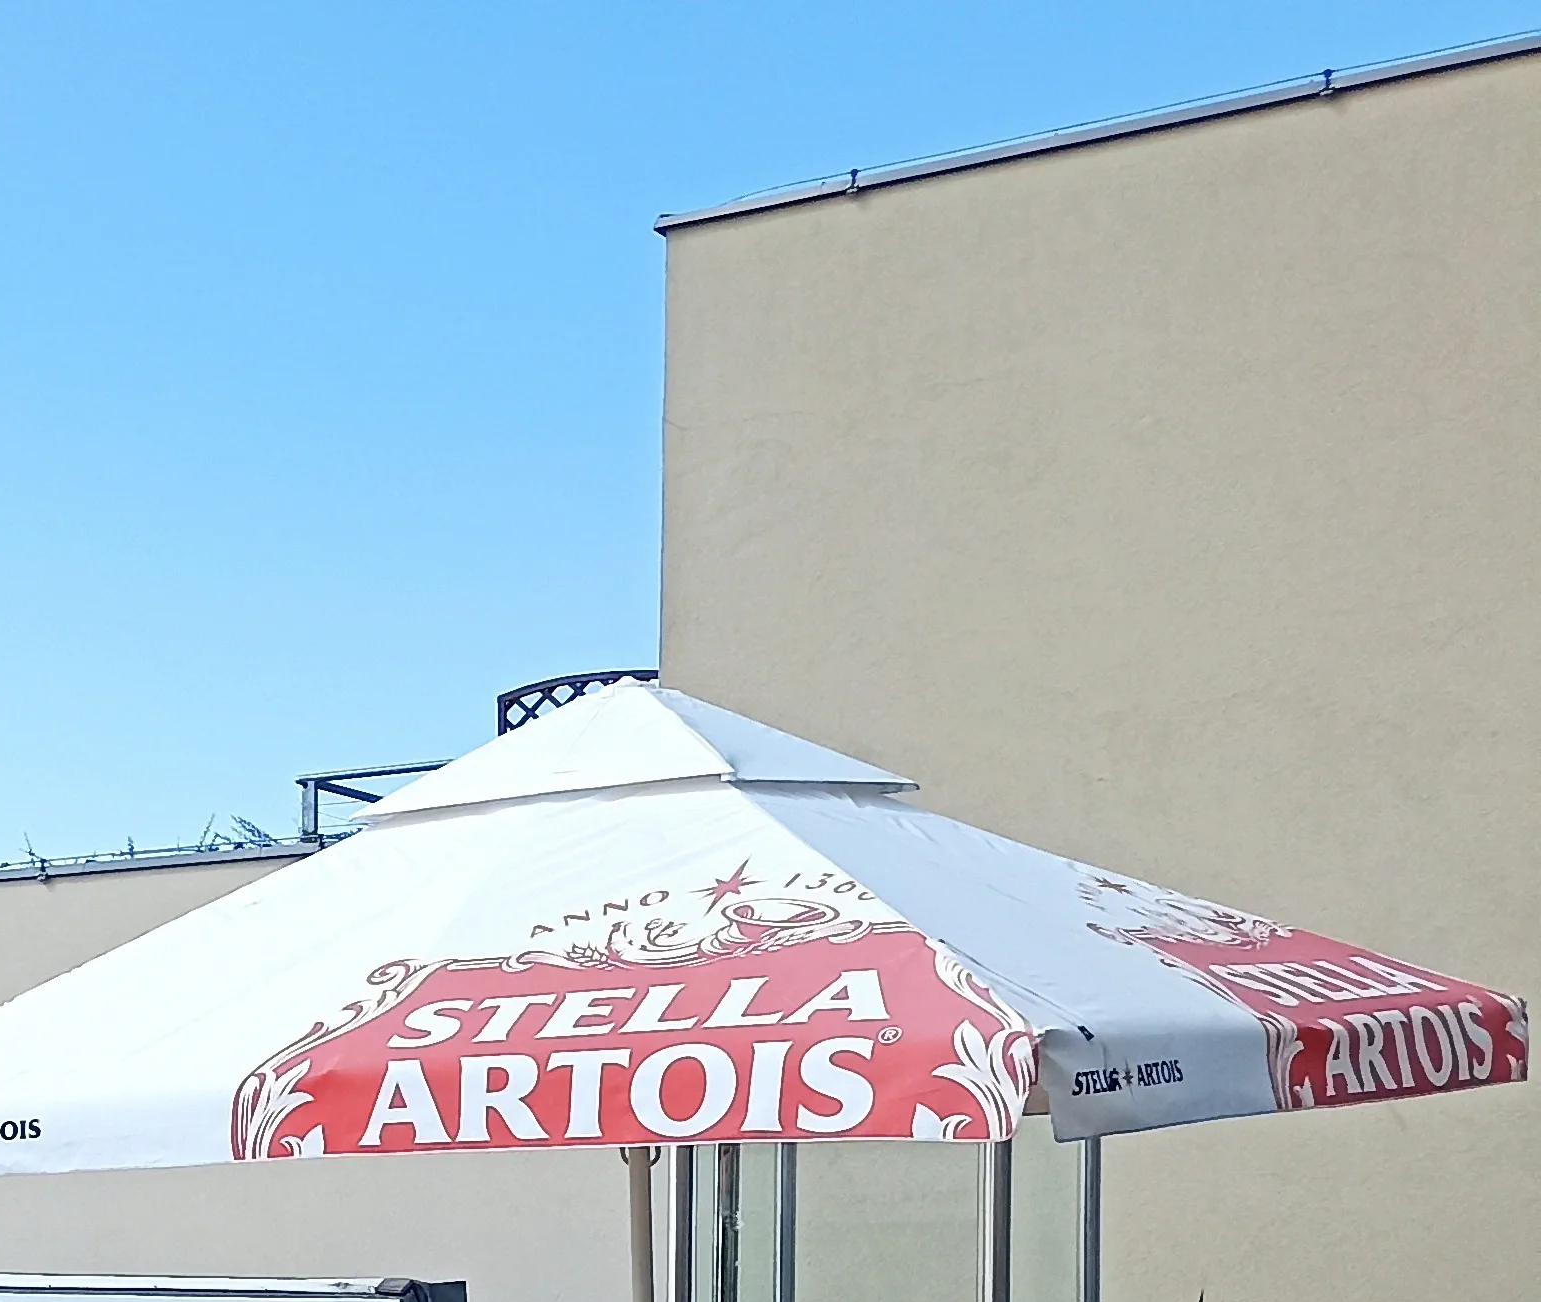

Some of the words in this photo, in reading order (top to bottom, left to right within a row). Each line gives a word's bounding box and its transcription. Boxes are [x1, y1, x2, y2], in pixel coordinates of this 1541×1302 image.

[531, 890, 670, 938] ANNO
[1210, 956, 1450, 1007] STELLA
[386, 969, 891, 1049] STELLA
[1137, 1059, 1184, 1087] ARTOIS
[1316, 1000, 1494, 1098] ARTOIS
